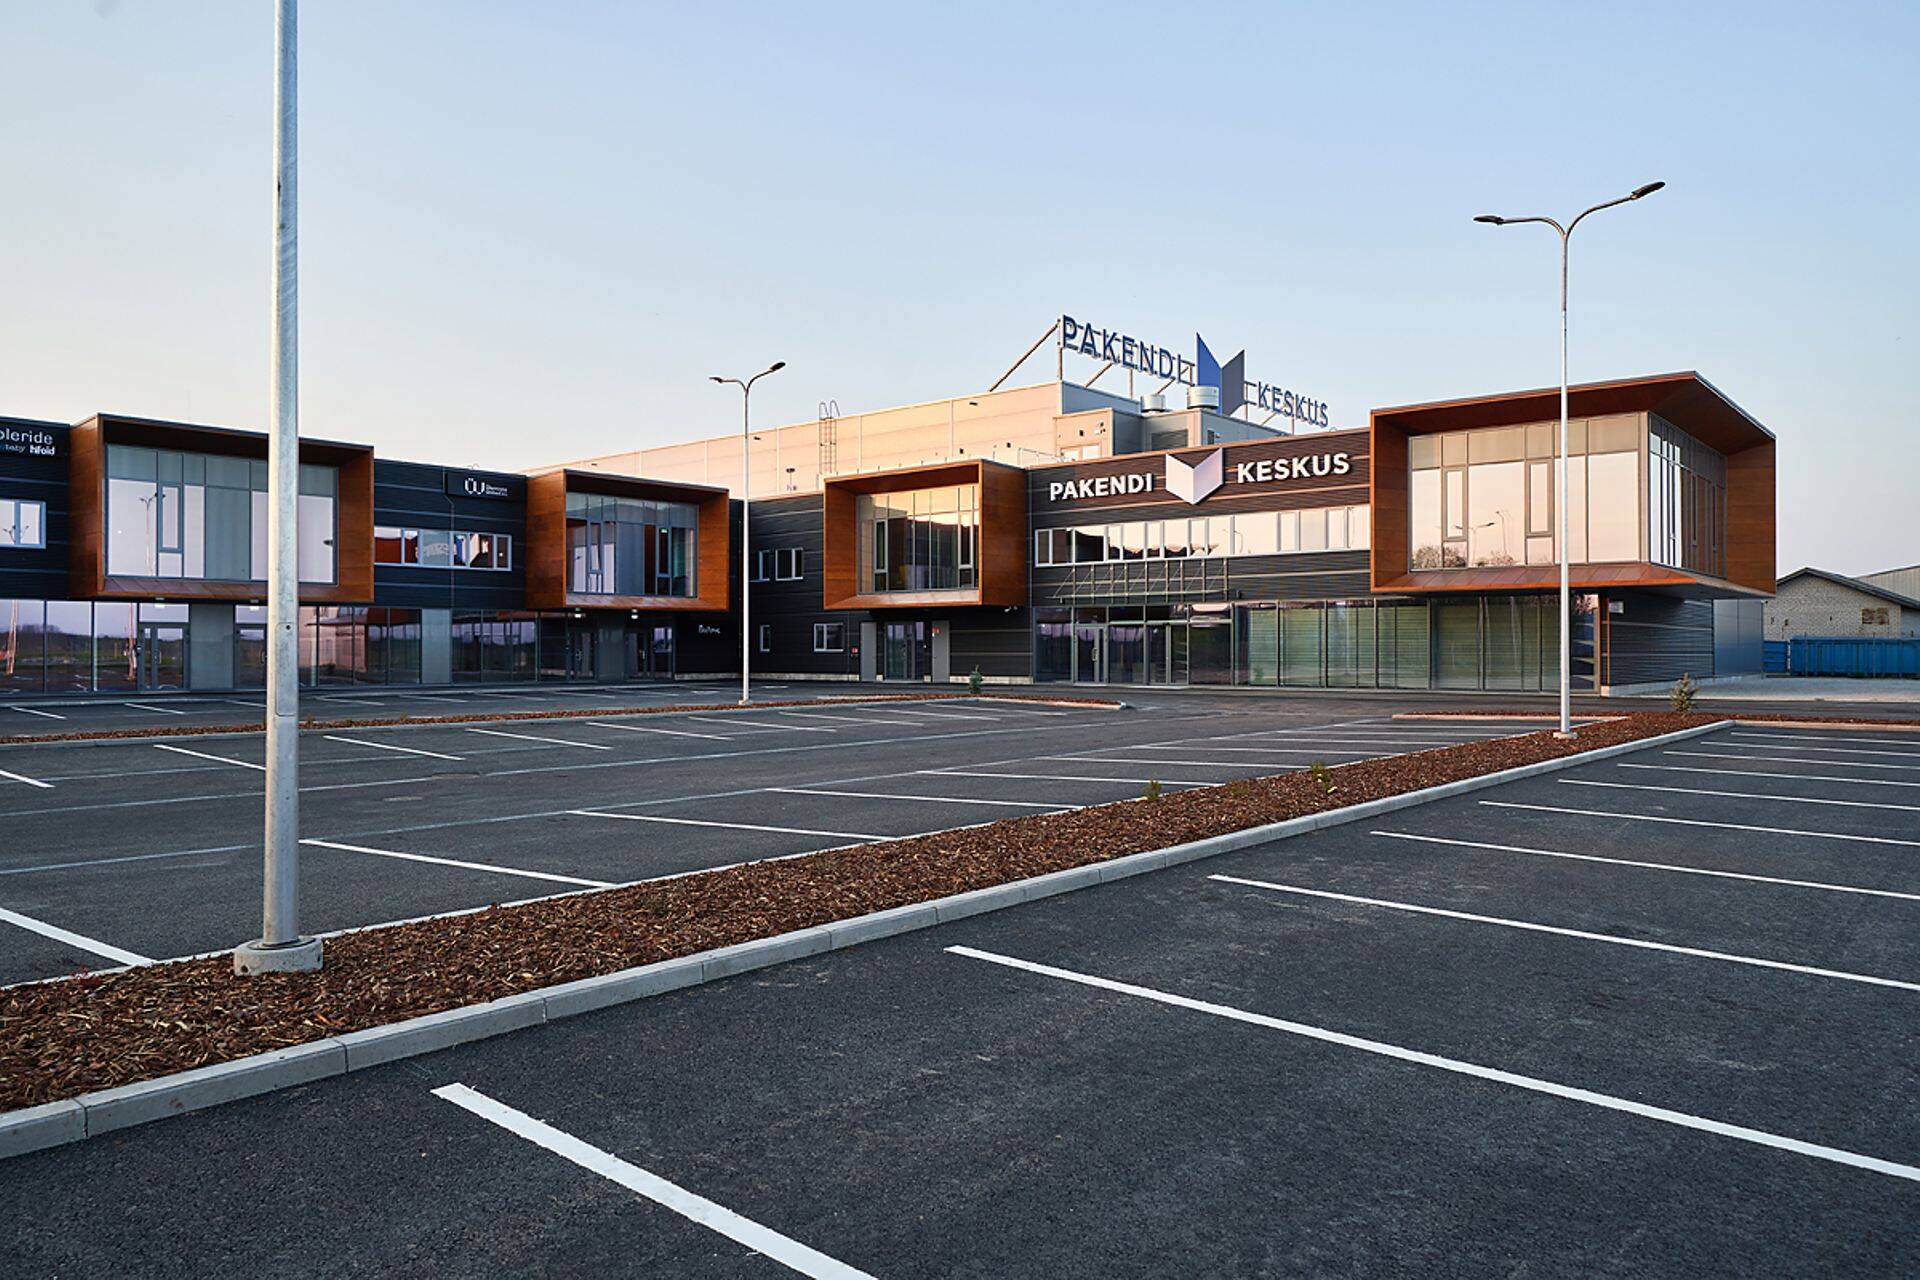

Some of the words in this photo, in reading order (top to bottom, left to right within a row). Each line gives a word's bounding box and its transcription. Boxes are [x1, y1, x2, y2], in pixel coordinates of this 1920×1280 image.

[1062, 315, 1181, 384] PAKENDI
[1258, 381, 1329, 427] KESKUS
[1049, 473, 1153, 501] PAKENDI
[1237, 453, 1350, 484] KESKUS
